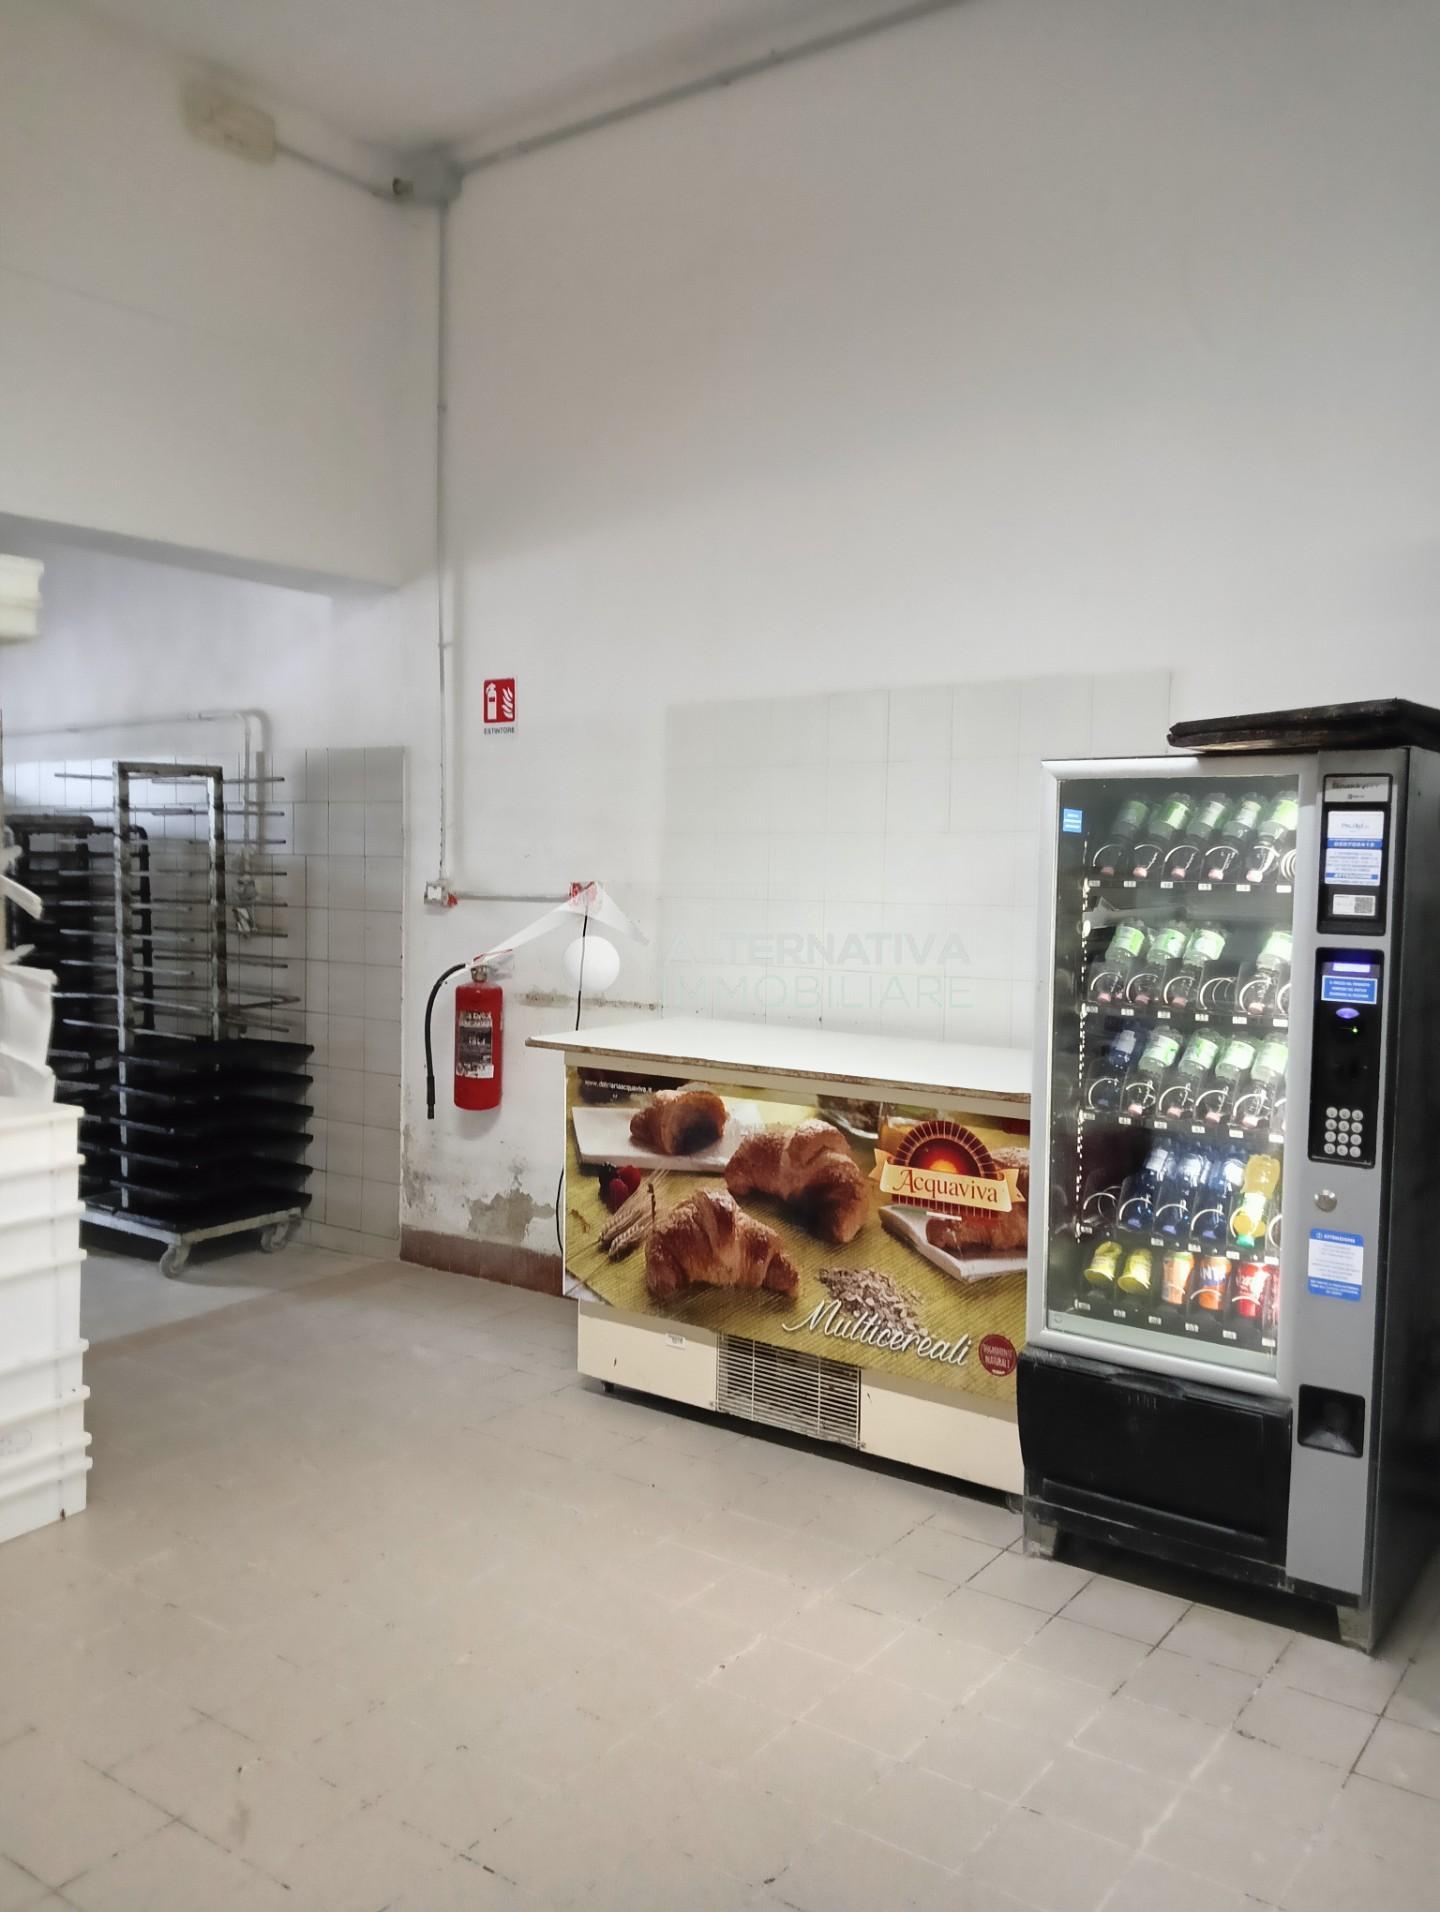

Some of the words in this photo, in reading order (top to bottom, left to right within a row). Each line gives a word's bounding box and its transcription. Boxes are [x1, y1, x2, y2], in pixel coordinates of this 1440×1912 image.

[483, 727, 515, 735] ESTINTORE
[891, 1168, 999, 1205] Acquaviva
[782, 1298, 973, 1367] Multicereali
